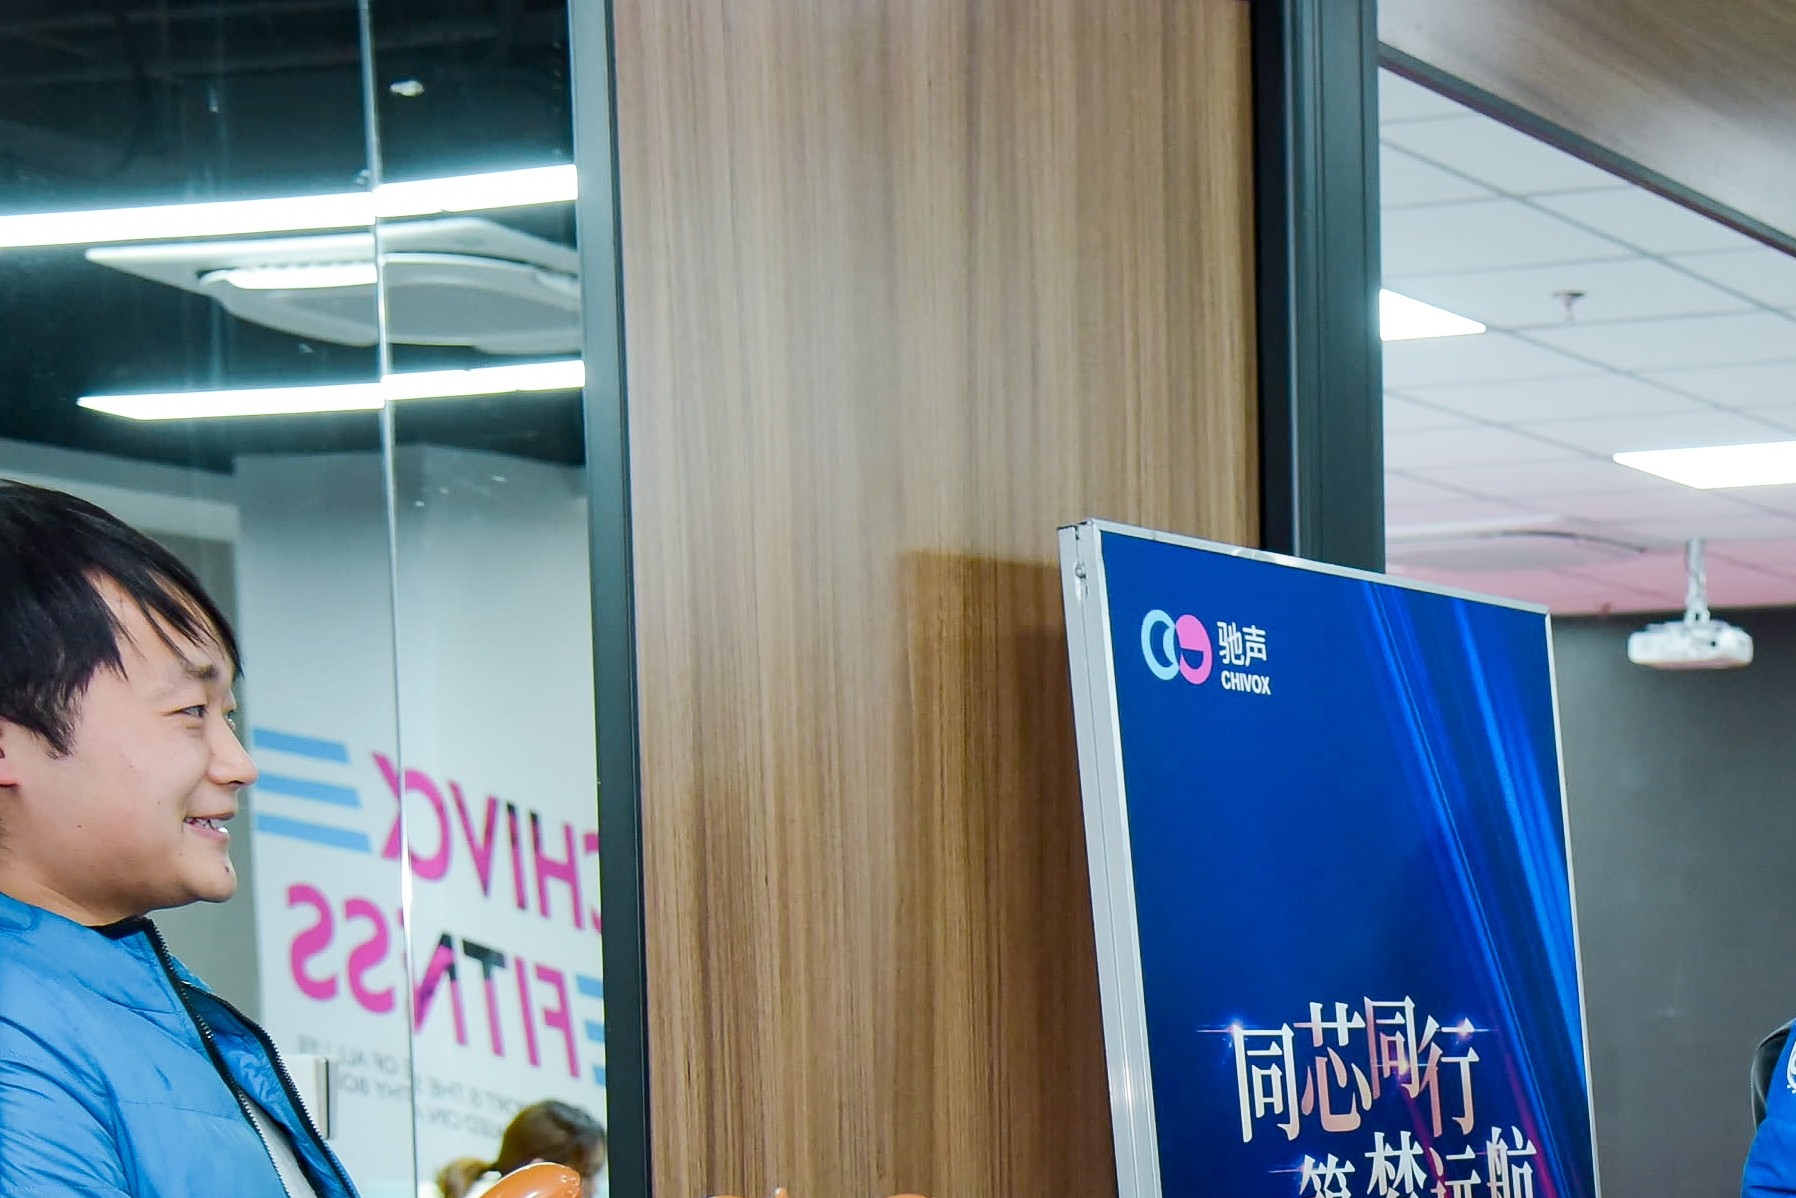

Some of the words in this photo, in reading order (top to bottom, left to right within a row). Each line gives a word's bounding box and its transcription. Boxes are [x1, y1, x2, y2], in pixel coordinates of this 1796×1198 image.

[1216, 621, 1268, 666] 驰声
[1220, 670, 1272, 696] CHIVOX
[1233, 995, 1480, 1143] 同芯同行
